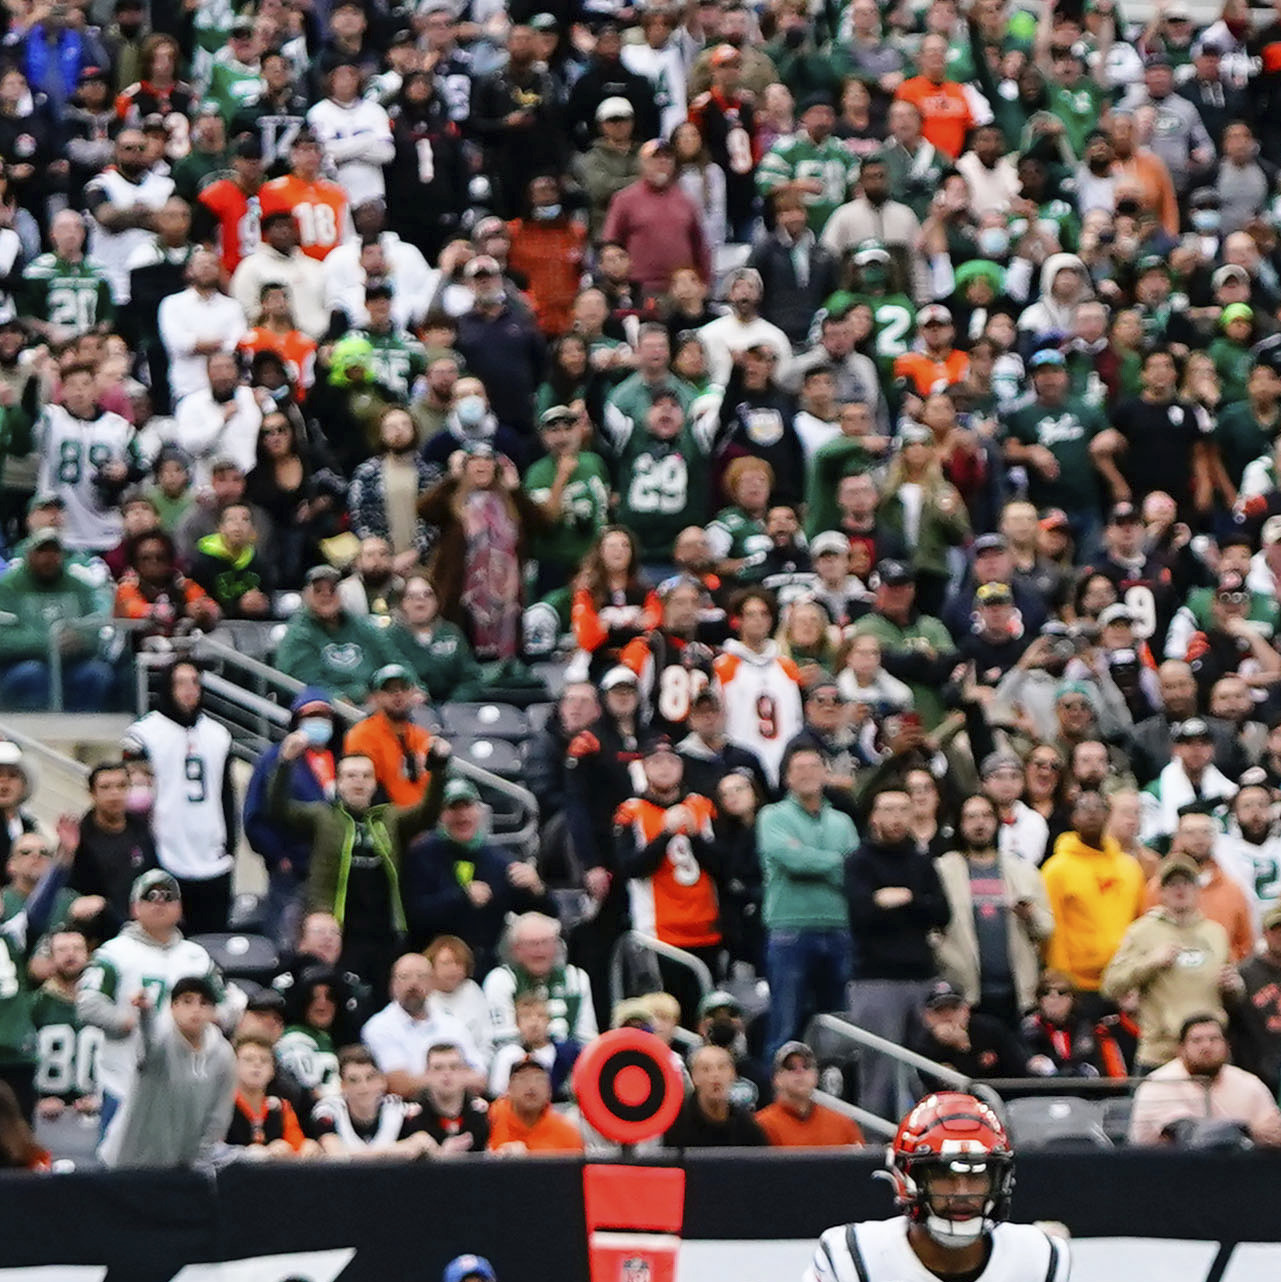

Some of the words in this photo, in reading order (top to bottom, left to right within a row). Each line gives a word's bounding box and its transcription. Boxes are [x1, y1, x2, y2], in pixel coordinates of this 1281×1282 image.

[292, 201, 337, 247] 18
[876, 304, 911, 357] 2
[627, 452, 691, 515] 29
[757, 693, 779, 741] 9
[185, 754, 207, 803] 9
[36, 1022, 102, 1094] 80
